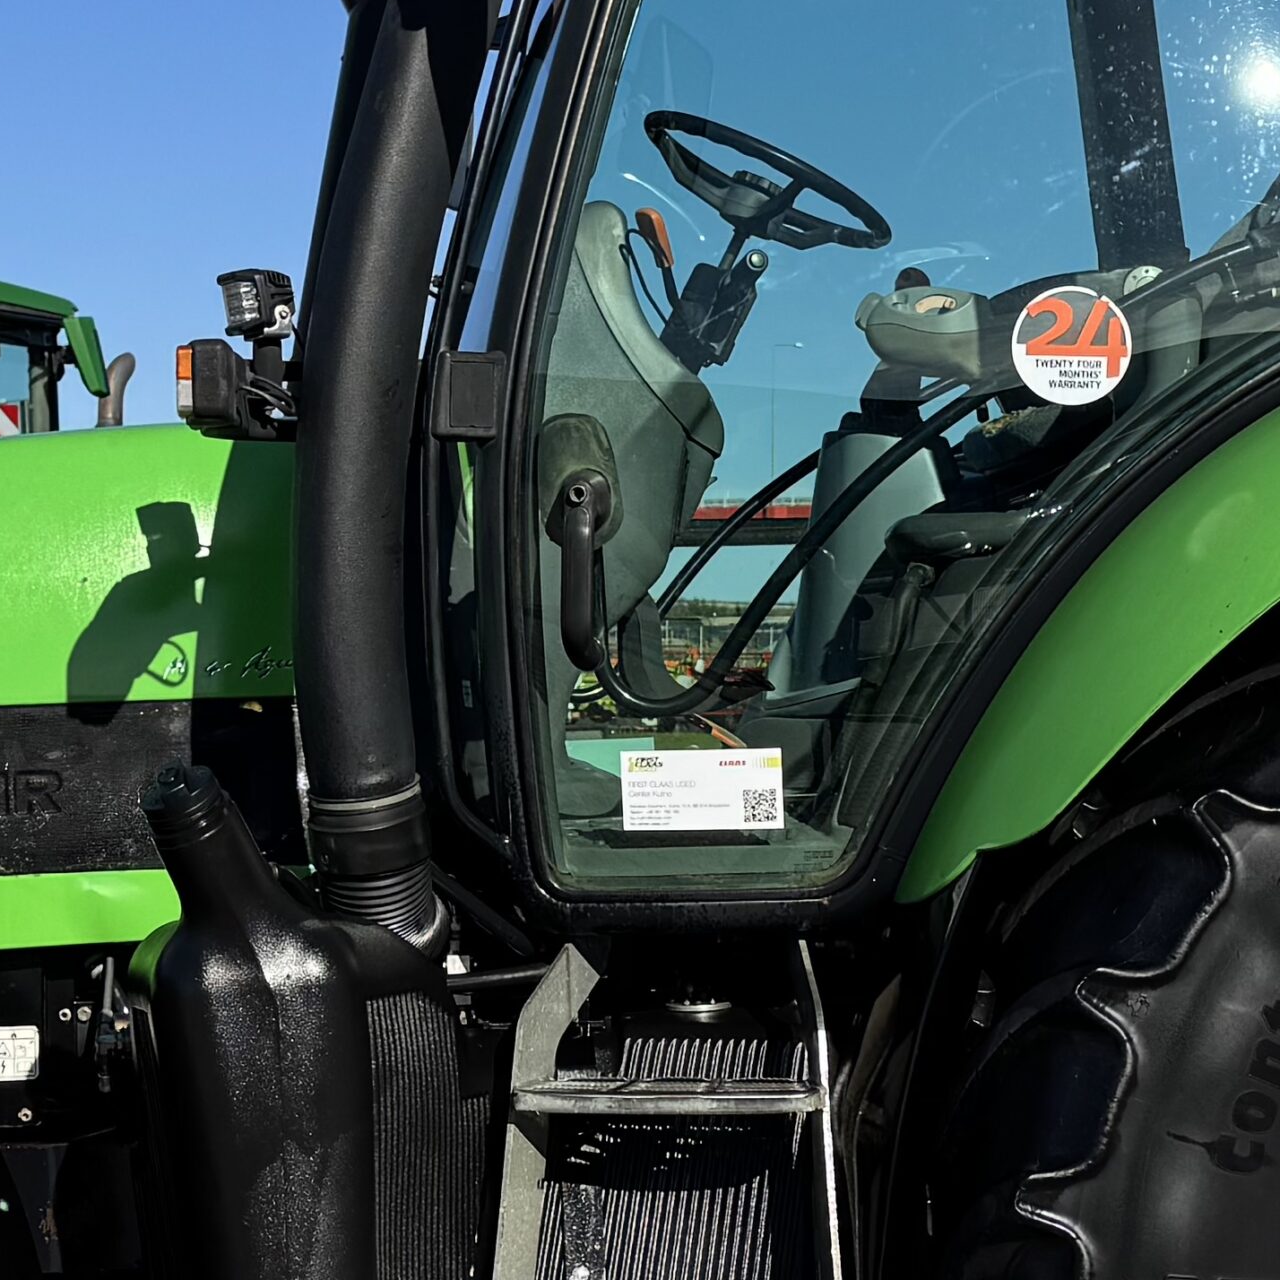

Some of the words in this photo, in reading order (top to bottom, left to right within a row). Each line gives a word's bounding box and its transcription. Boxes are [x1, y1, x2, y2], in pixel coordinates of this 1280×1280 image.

[1026, 297, 1127, 378] 24
[1035, 359, 1073, 369] TWENTY
[1077, 360, 1102, 369] FOUR
[1048, 380, 1102, 389] WARRANTY
